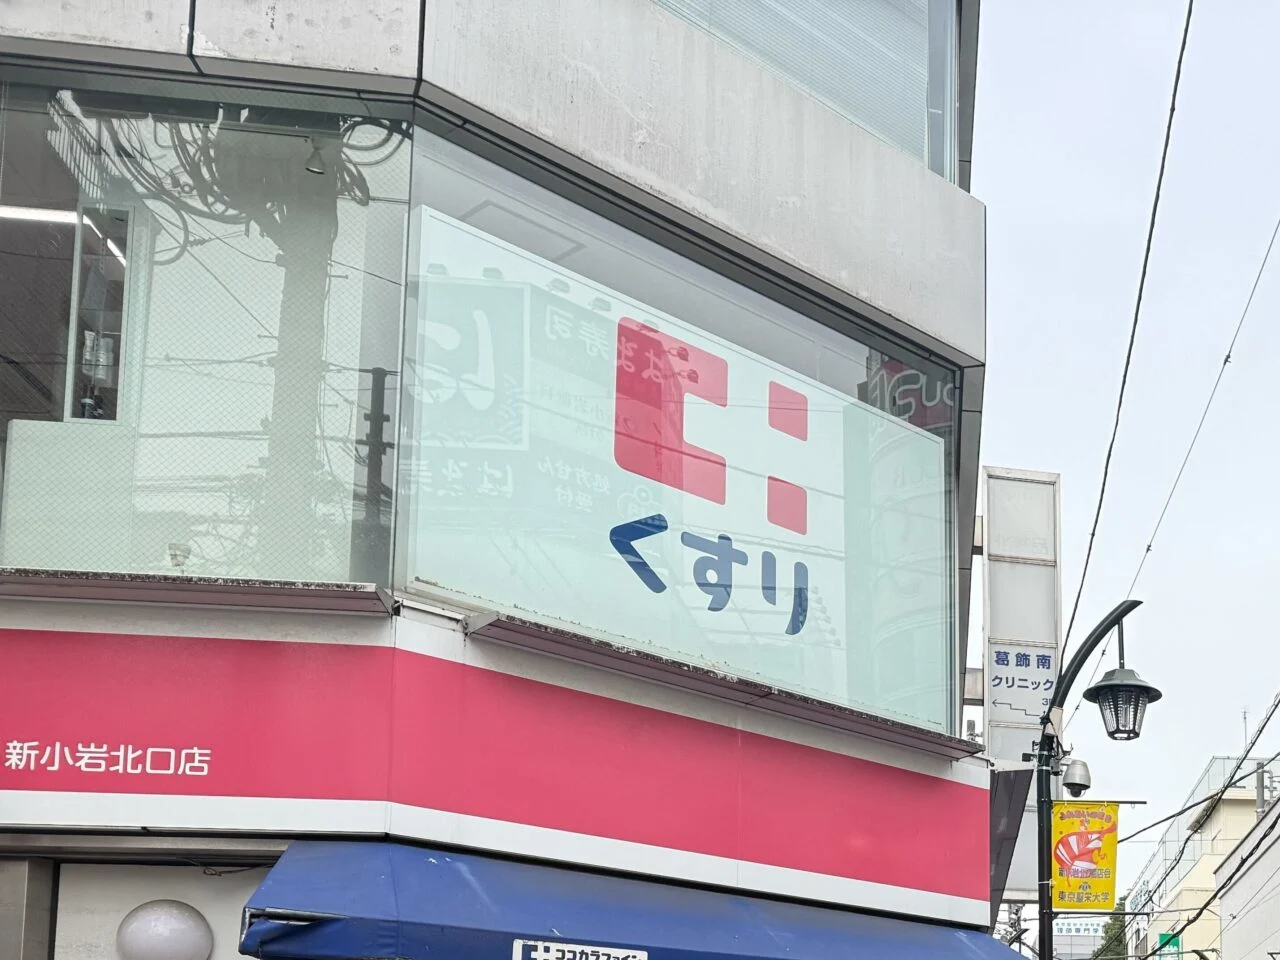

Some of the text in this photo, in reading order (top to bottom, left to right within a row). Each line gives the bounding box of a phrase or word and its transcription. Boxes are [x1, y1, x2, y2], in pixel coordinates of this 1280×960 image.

[609, 513, 809, 635] くすり
[994, 650, 1052, 669] 葛飾南
[991, 675, 1054, 691] クリニック
[5, 740, 212, 775] 新小岩北口店
